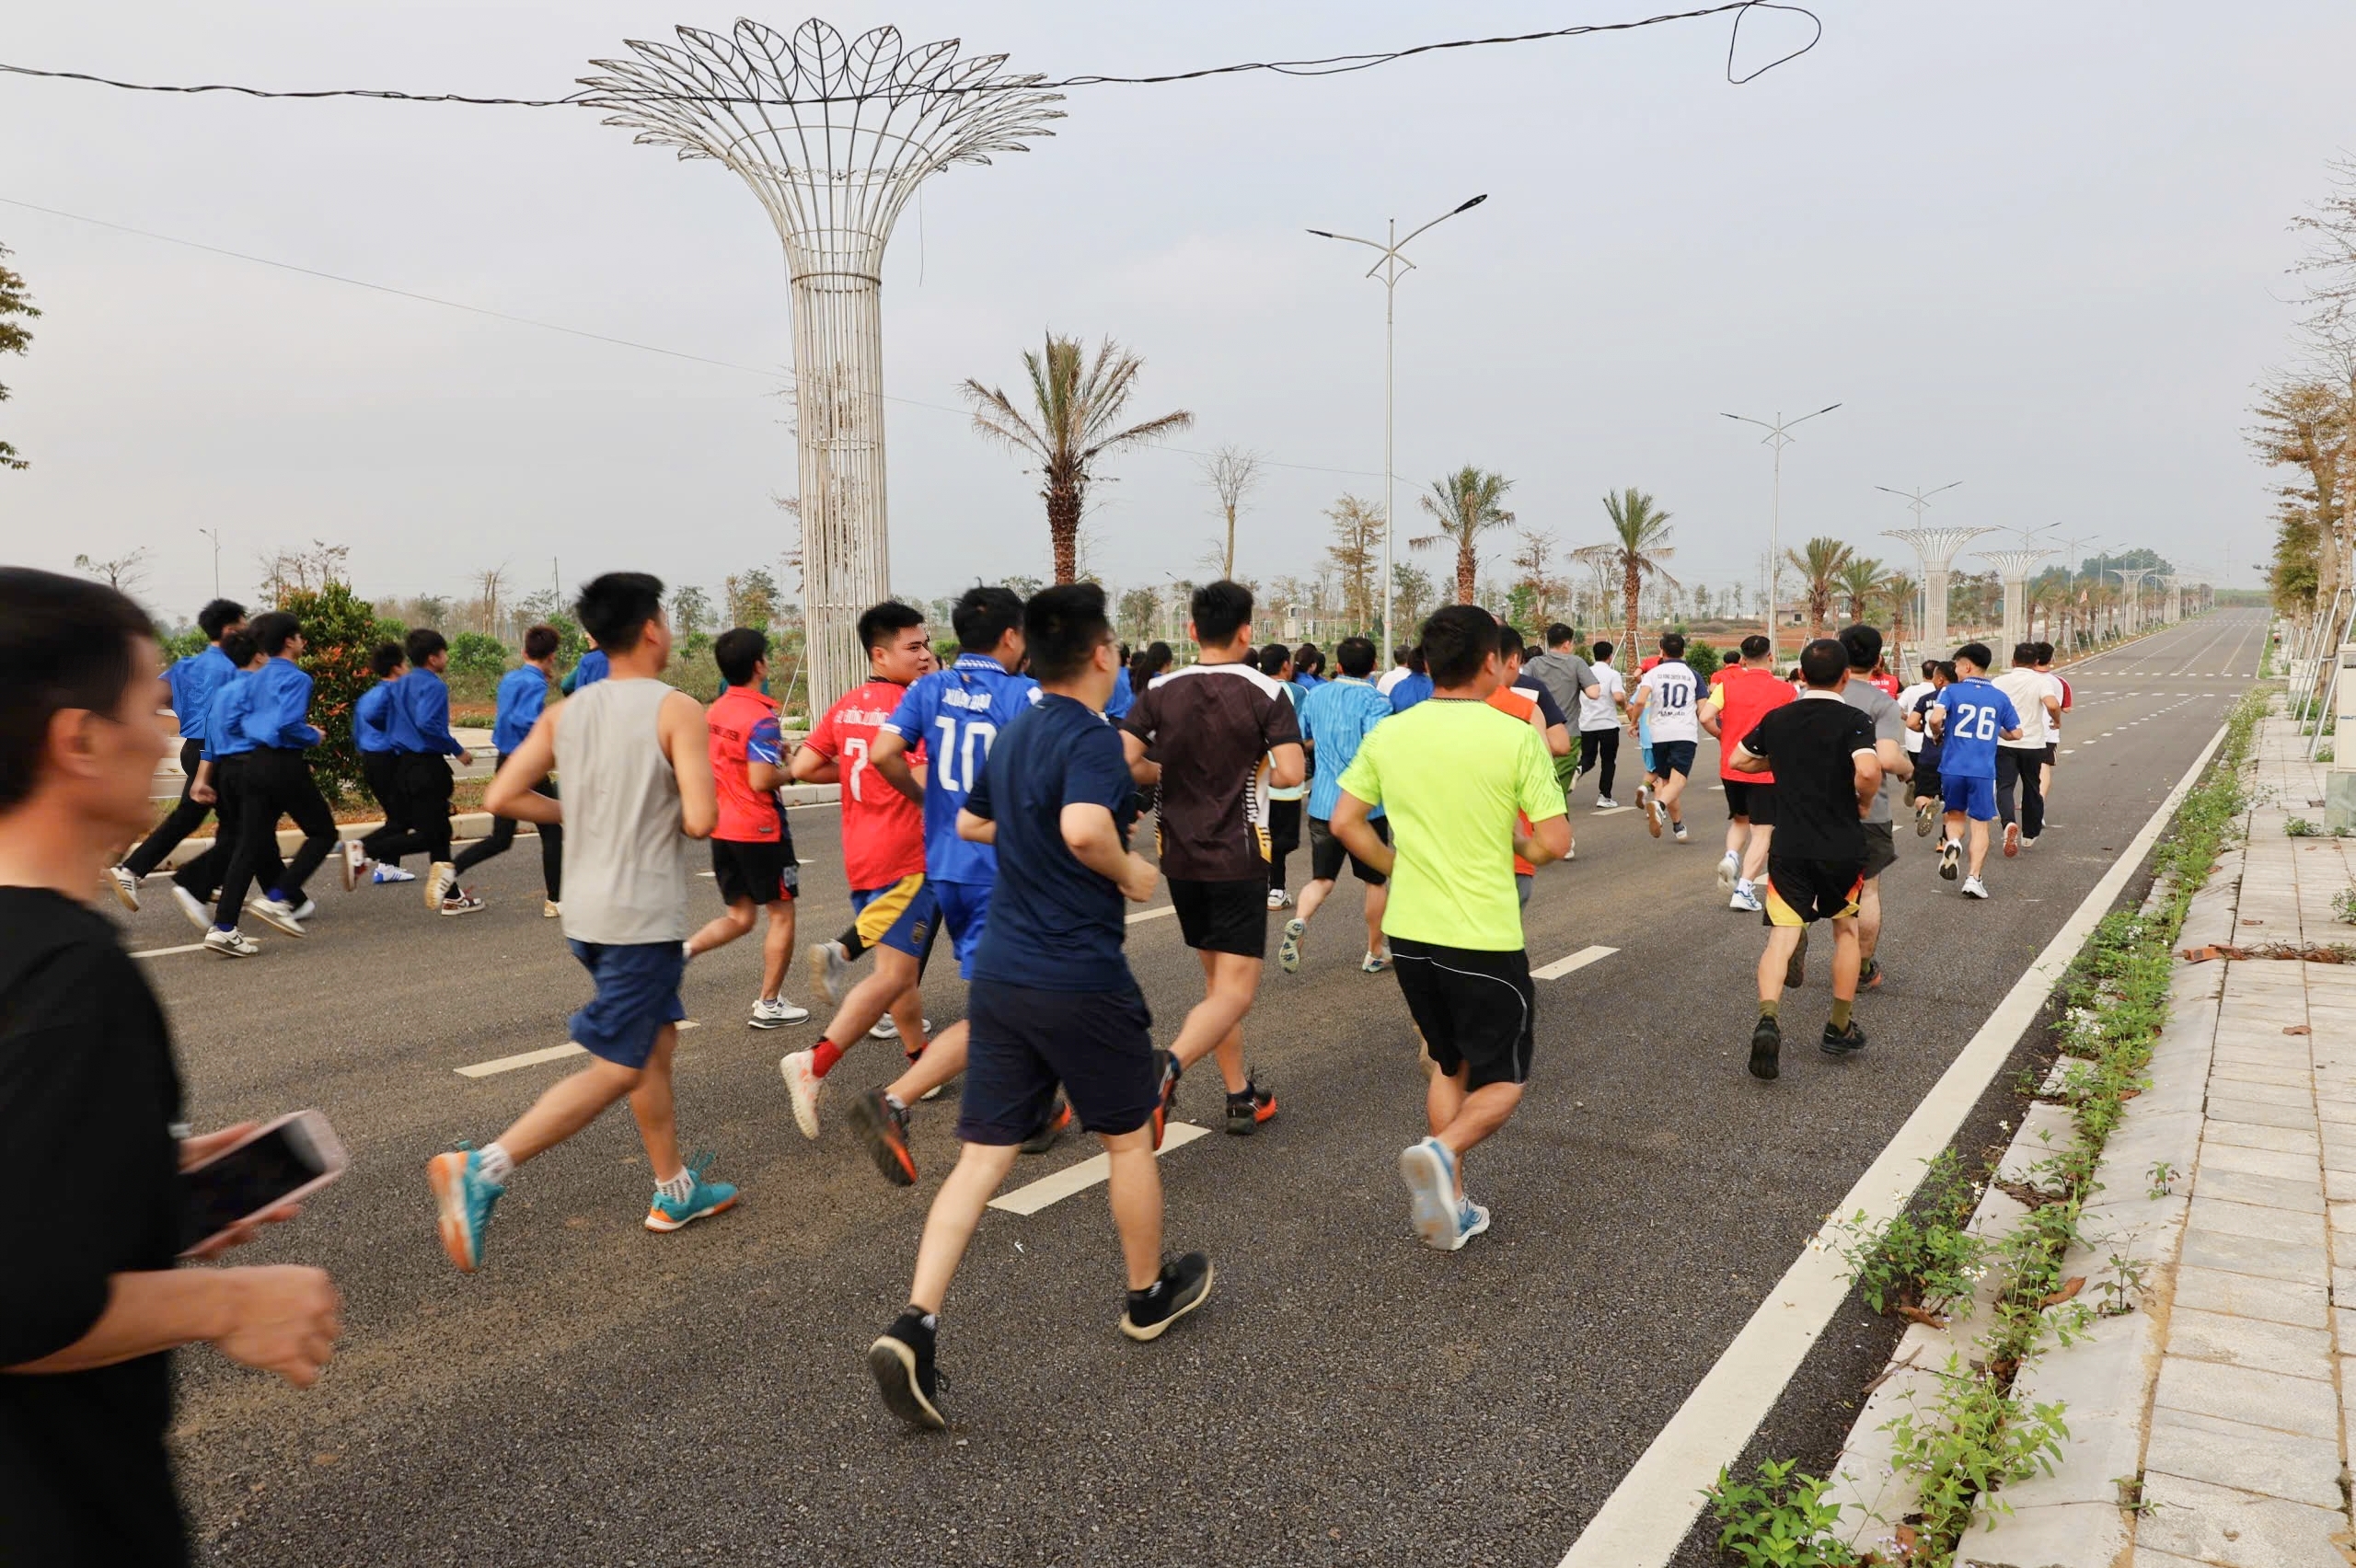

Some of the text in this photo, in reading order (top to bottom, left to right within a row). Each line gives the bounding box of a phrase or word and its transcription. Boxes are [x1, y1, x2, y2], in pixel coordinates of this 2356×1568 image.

[1661, 682, 1689, 709] 10
[1954, 703, 1997, 741] 26
[844, 737, 869, 802] 7
[935, 715, 998, 794] 10
